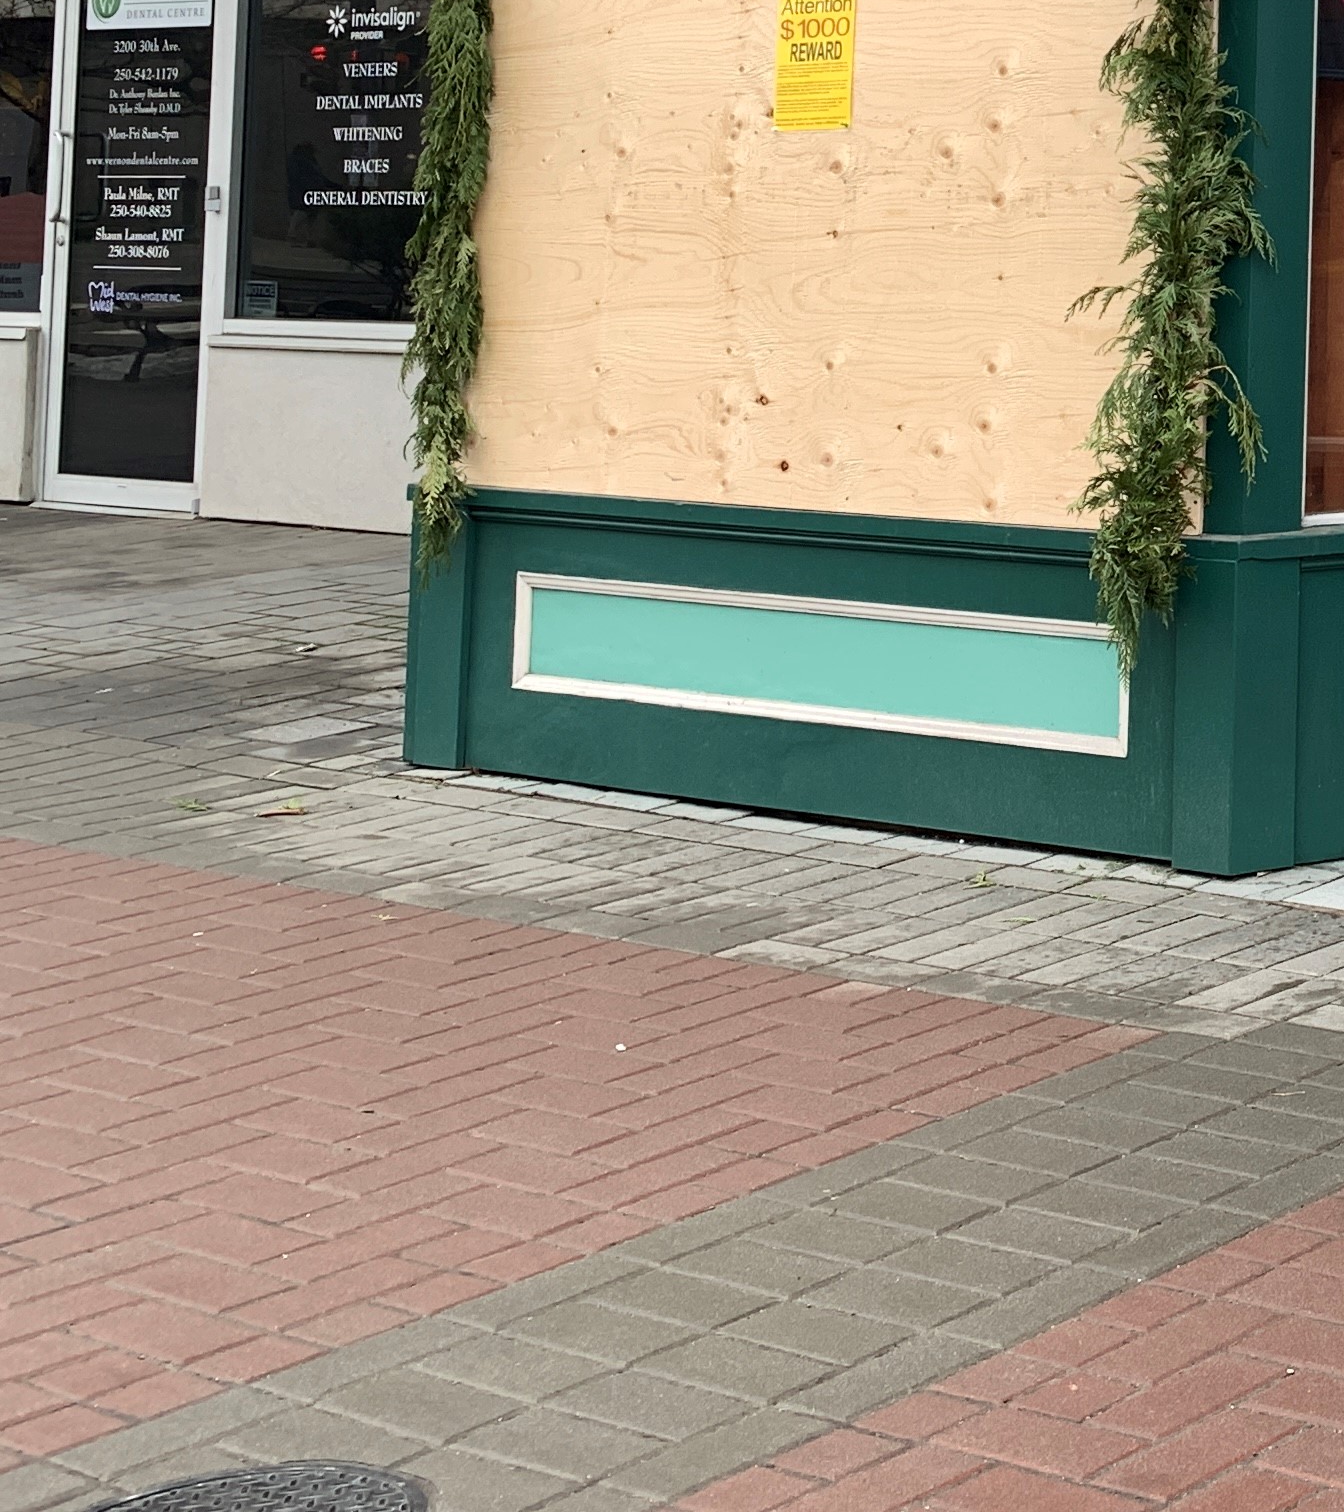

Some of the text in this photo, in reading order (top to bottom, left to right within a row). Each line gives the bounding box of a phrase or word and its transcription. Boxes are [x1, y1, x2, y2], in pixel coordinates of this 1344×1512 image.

[127, 7, 205, 19] DENTAL CENTRE
[351, 6, 415, 31] invisalign
[350, 30, 384, 40] PROVIDER
[113, 38, 181, 53] 3200 30th Ave.
[790, 40, 842, 62] REWARD
[113, 68, 179, 81] 250-542-1179
[343, 62, 398, 77] VENEERS
[316, 93, 423, 110] DENTAL IMPLANTS
[108, 126, 179, 142] Mon-Fri 8am-5pm
[333, 126, 403, 141] WHITENING
[86, 151, 199, 165] www.vernondentalcentre.com
[343, 159, 390, 173] BRACES
[104, 186, 126, 200] Paula
[157, 187, 180, 201] RMT
[303, 191, 428, 206] GENERAL DENTISTRY
[110, 205, 172, 217] 250-540-8825
[95, 226, 184, 242] Shaun Lamont, RMT
[108, 245, 170, 258] 250-308-8076
[88, 281, 115, 298] Mid
[116, 292, 140, 302] DENTAL
[89, 298, 115, 313] West
